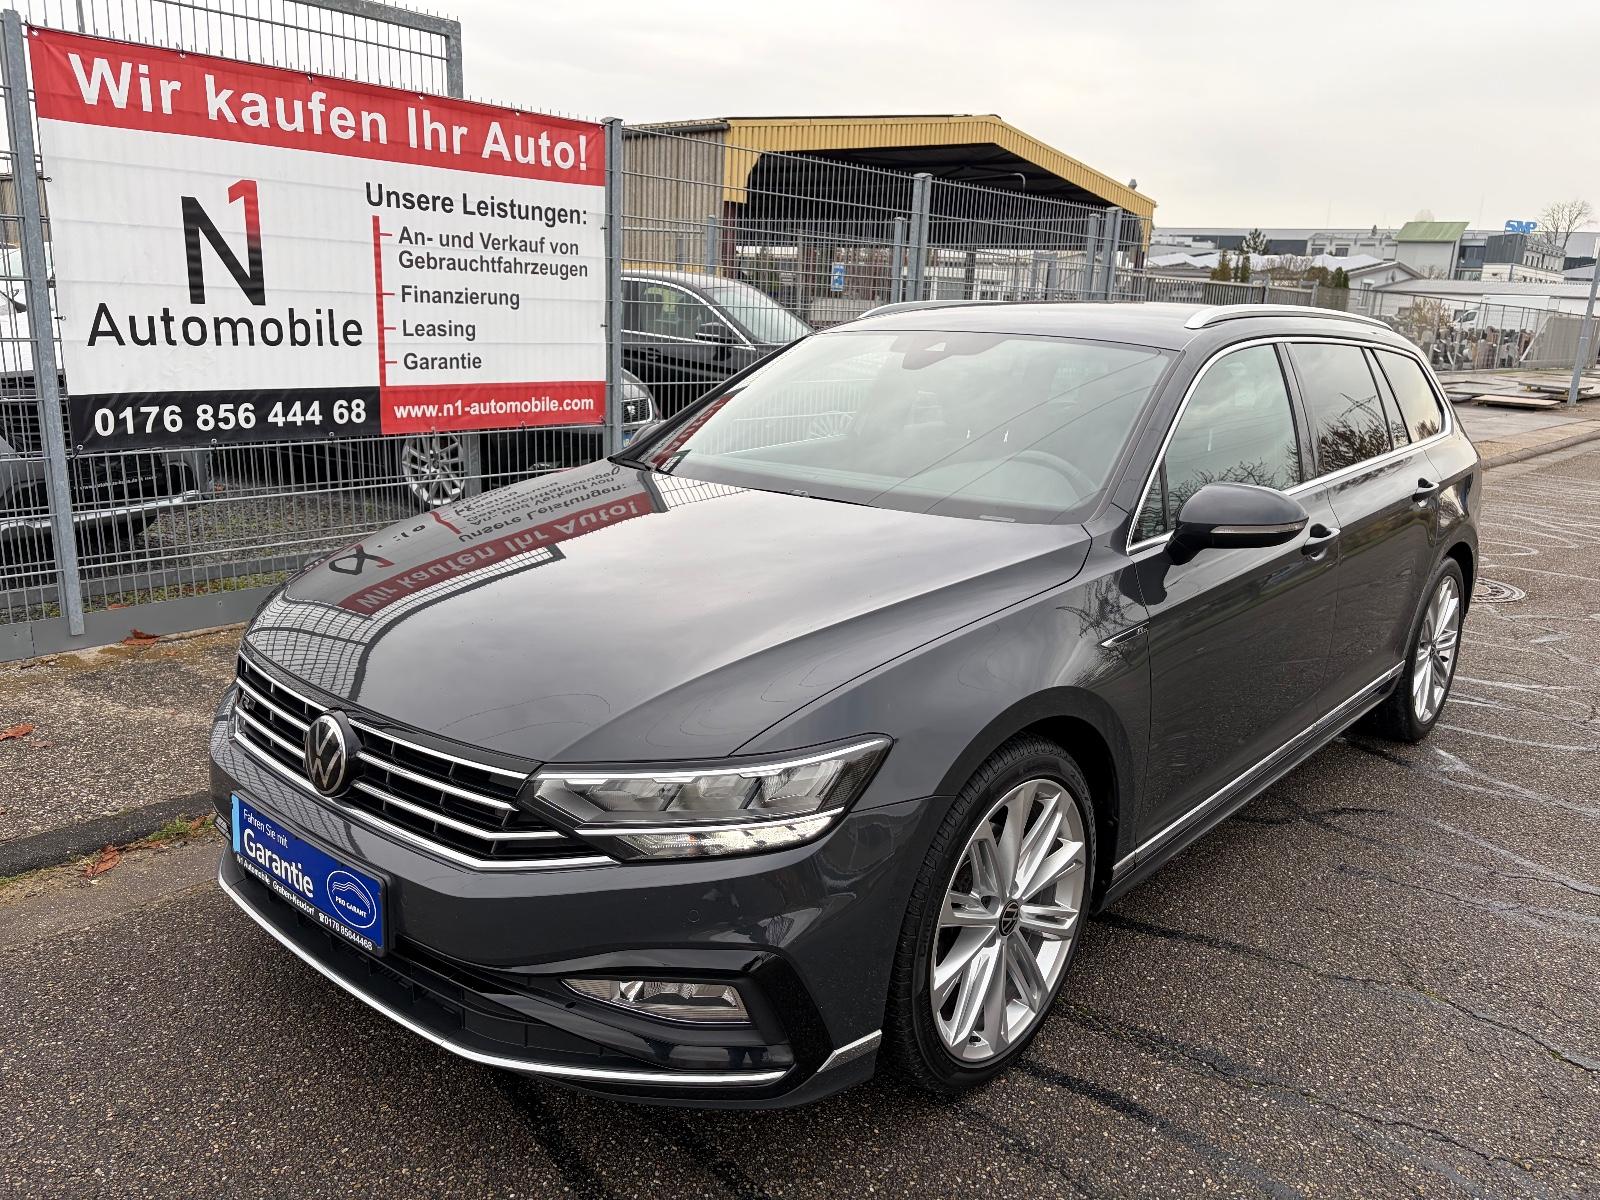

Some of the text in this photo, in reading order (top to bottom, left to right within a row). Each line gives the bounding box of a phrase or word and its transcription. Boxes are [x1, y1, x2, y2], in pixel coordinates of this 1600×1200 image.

[68, 52, 587, 171] Wir kaufen Ihr Auto!
[365, 182, 588, 228] Unsere Leistungen:
[181, 179, 266, 306] N1
[398, 226, 579, 256] An- und Verkauf von
[398, 250, 588, 281] Gebrauchtfahrzeugen
[401, 285, 520, 310] Finanzierung
[87, 302, 363, 347] Automobile
[402, 319, 476, 341] Leasing
[403, 352, 482, 370] Garantie
[94, 399, 367, 437] 0176 856 444 68
[394, 396, 594, 418] www.n1-automobile.com
[243, 808, 288, 848] Fahren Sie mit
[244, 828, 313, 898] Garantie
